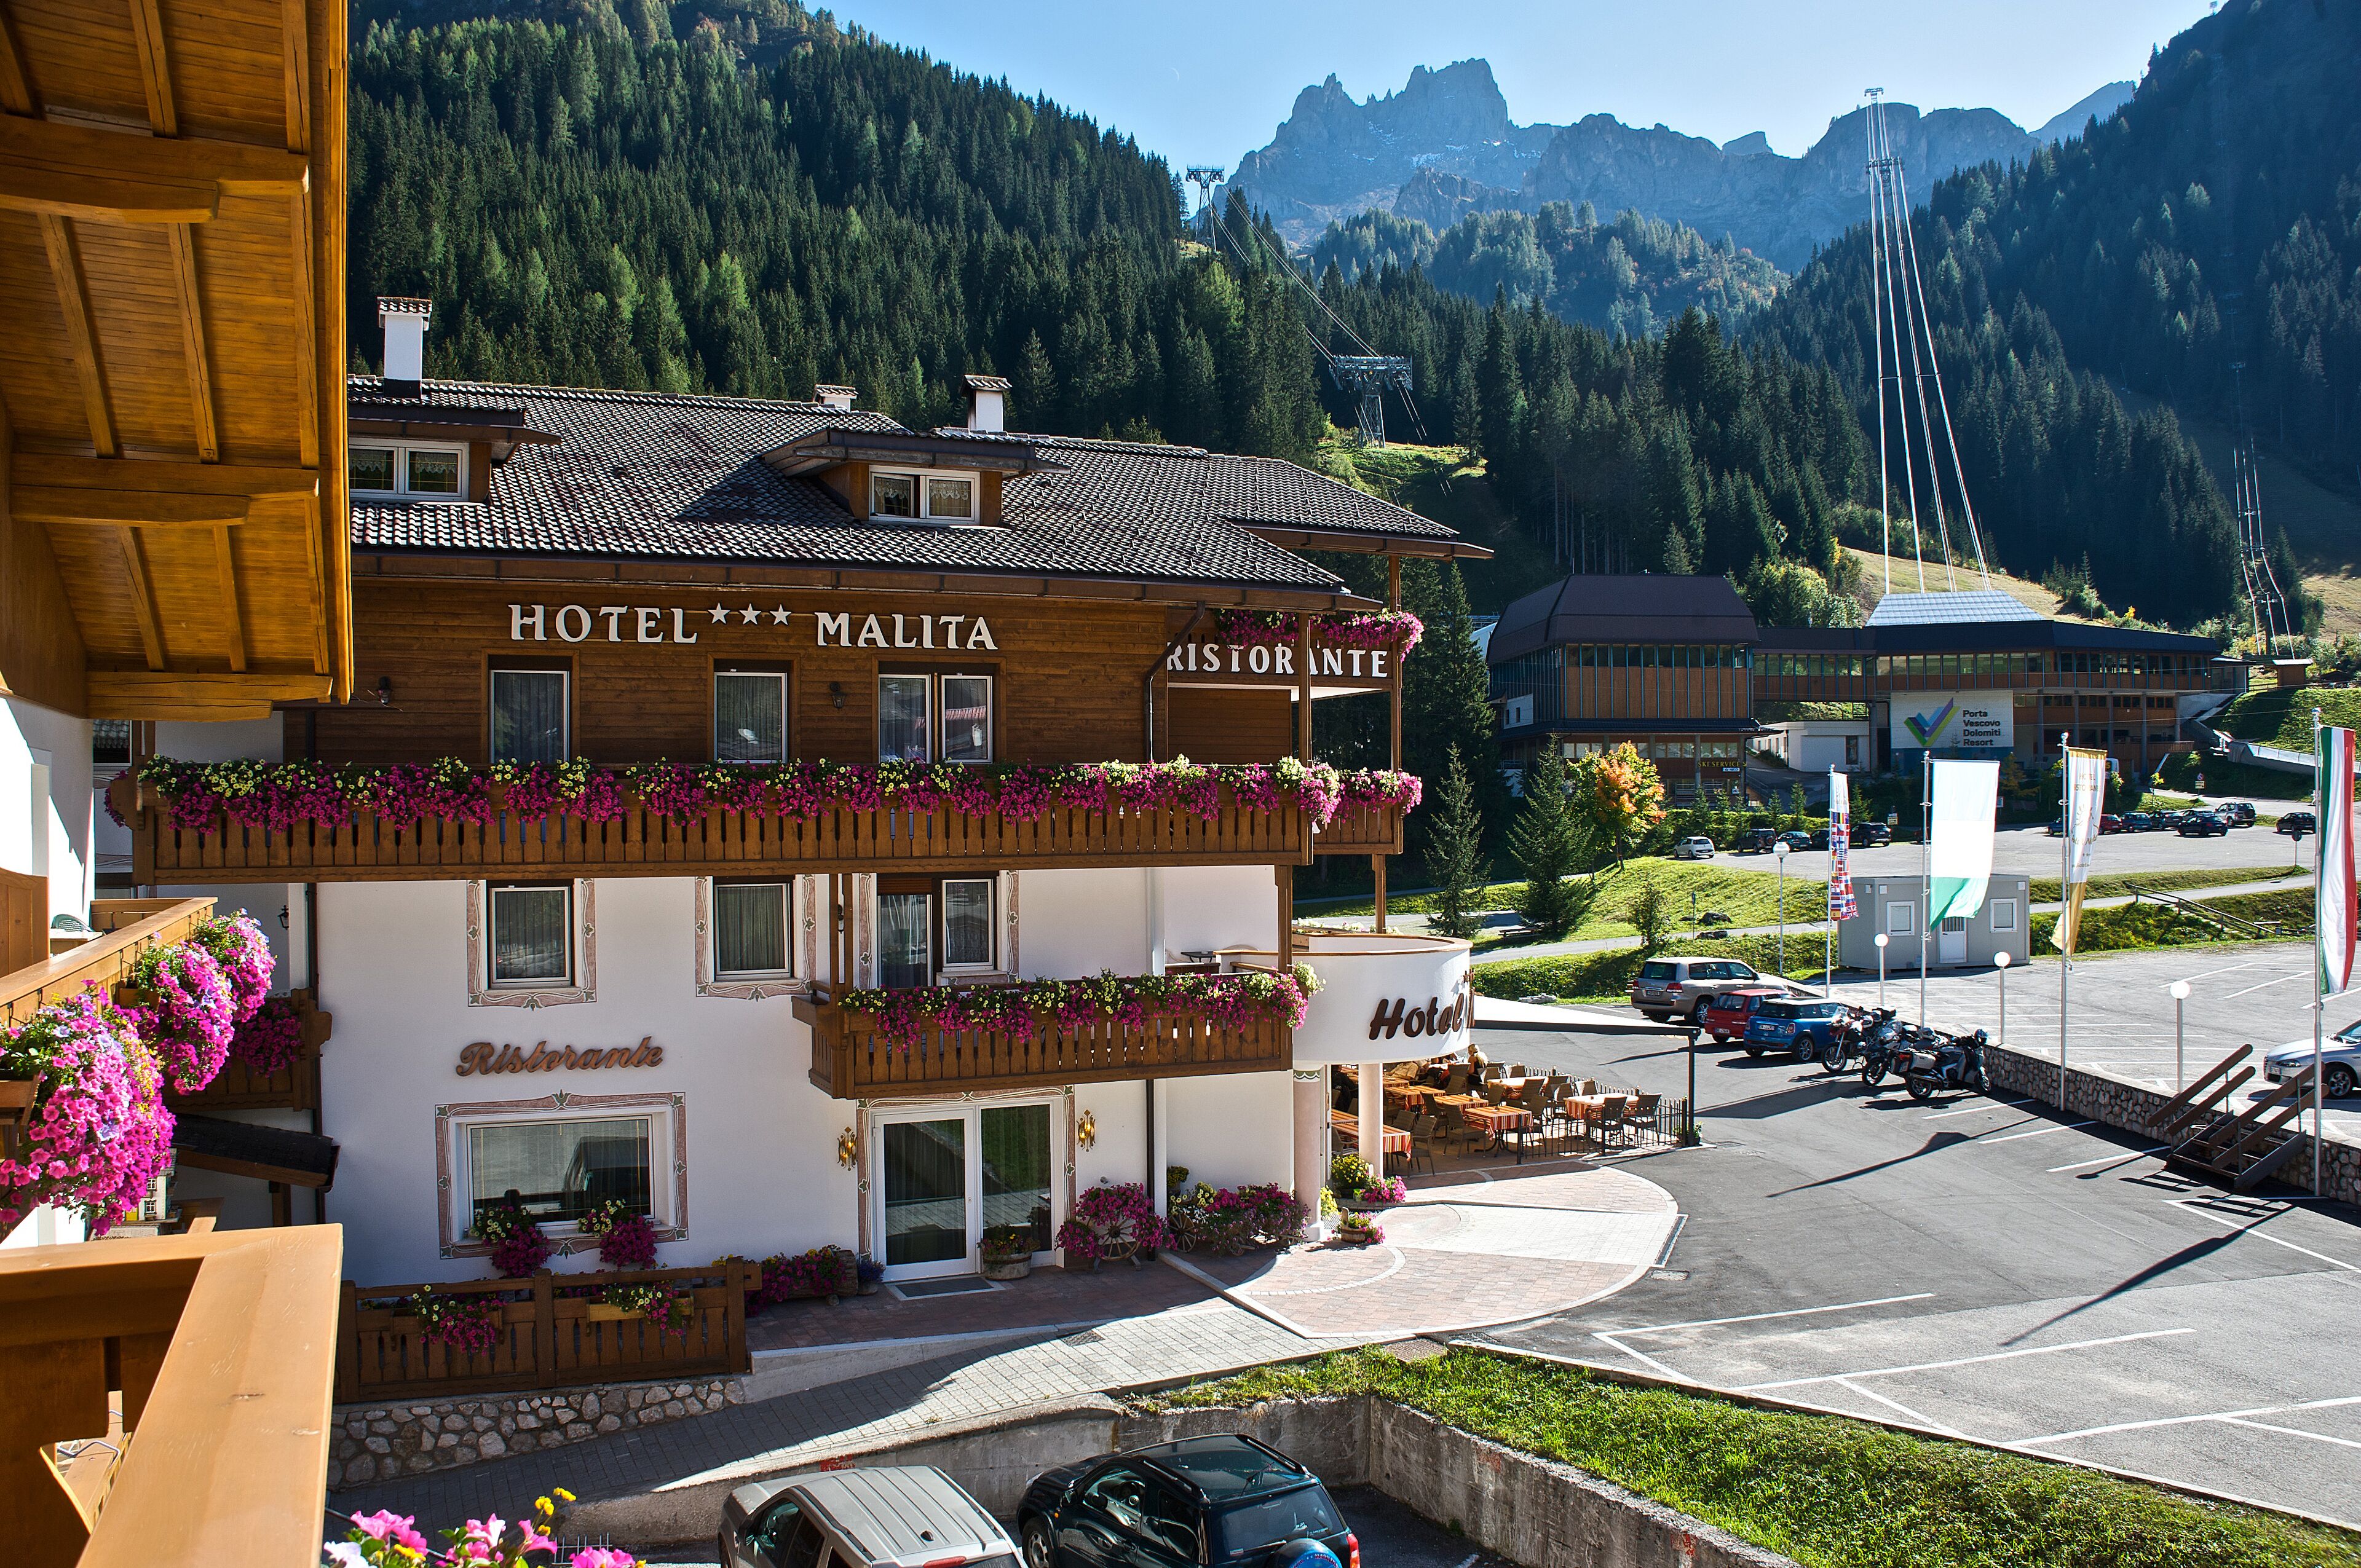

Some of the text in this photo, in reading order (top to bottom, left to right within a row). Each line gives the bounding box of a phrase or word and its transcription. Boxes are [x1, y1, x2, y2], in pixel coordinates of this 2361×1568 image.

[508, 604, 999, 650] HOTEL MALITA
[1369, 993, 1465, 1040] Hotel
[456, 1036, 663, 1077] Ristorante
